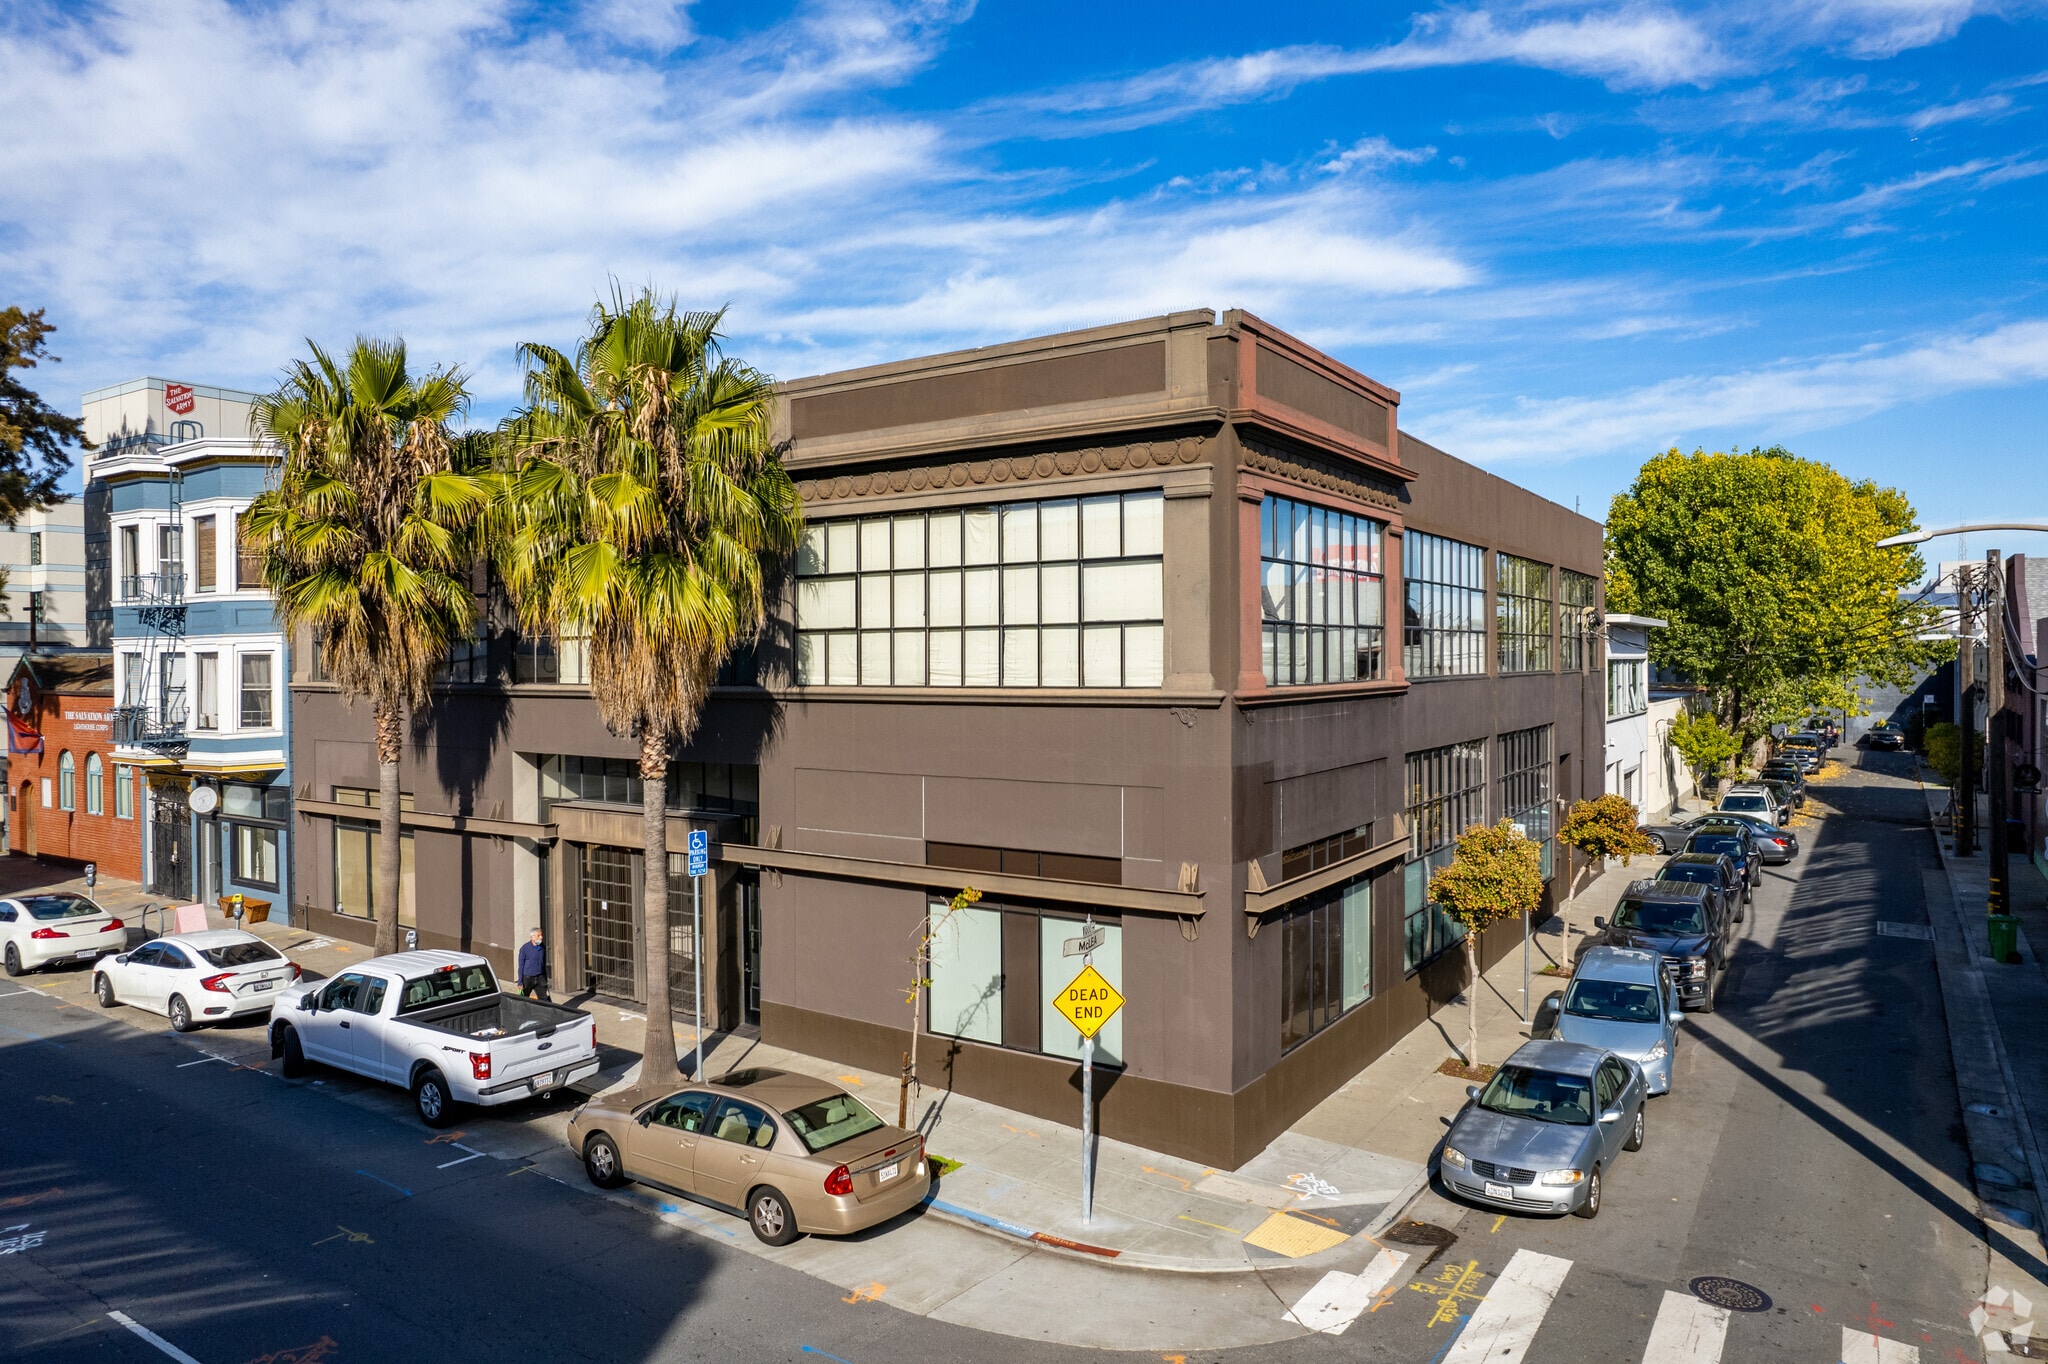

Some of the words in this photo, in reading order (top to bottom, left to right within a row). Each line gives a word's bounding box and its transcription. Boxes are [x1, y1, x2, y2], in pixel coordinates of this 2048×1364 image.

[170, 388, 182, 396] THE
[166, 391, 192, 406] SALVATION
[175, 400, 192, 411] ARMY
[65, 711, 75, 720] THE
[75, 711, 103, 721] SALVATION
[690, 848, 706, 856] PARKING
[693, 855, 703, 863] ONLY
[1079, 935, 1098, 951] McLEA
[1070, 988, 1108, 1001] DEAD
[1075, 1006, 1103, 1018] END
[442, 1045, 466, 1054] SPORT
